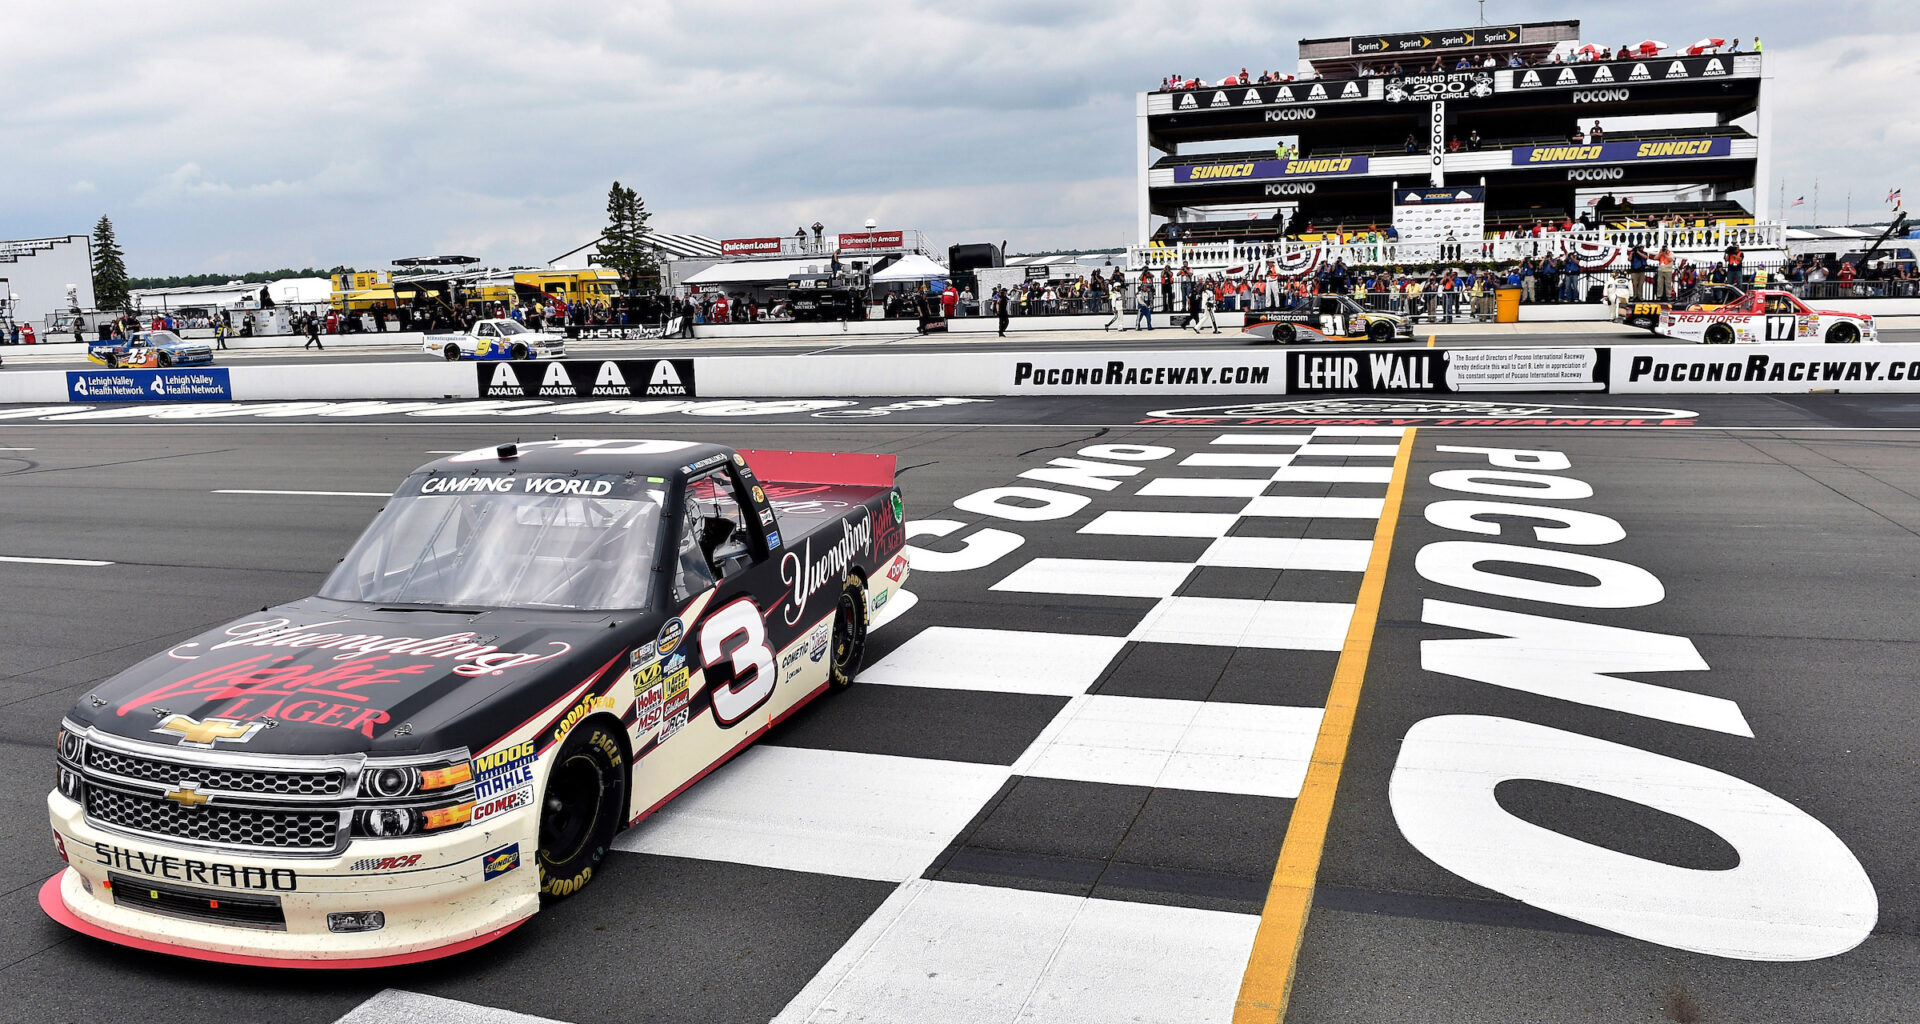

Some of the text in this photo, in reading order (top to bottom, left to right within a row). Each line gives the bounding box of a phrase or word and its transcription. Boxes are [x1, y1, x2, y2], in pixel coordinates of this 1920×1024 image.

[1400, 40, 1421, 49] Sprint
[1442, 36, 1463, 46] Sprint
[1485, 33, 1506, 42] Sprint
[1358, 42, 1379, 52] Sprint
[1405, 72, 1474, 84] RICHARD PETTY
[1414, 82, 1465, 94] 200
[1573, 88, 1630, 103] POCONO
[1408, 93, 1438, 102] VICTORY
[1265, 108, 1316, 122] POCONO
[1433, 103, 1442, 166] POCONO
[1530, 146, 1603, 162] SUNOCO
[1636, 140, 1712, 156] SUNOCO
[1190, 163, 1254, 180] SUNOCO
[1284, 158, 1352, 174] SUNOCO
[1568, 168, 1624, 181] POCONO
[1265, 182, 1316, 196] POCONO
[723, 241, 778, 251] Quicken Loans
[840, 236, 870, 246] Engineered
[1268, 314, 1308, 322] Heater.com
[1320, 314, 1345, 336] 31
[1678, 315, 1752, 324] RED HORSE
[1768, 317, 1794, 340] 17
[475, 339, 492, 356] 9
[128, 348, 148, 364] 23
[1564, 353, 1584, 361] Raceway
[1298, 354, 1434, 389] LEHR WALL
[1551, 362, 1580, 370] appreciation
[88, 376, 134, 386] Lehigh Valley
[165, 375, 213, 385] Lehigh Valley
[89, 386, 144, 395] Health Network
[167, 385, 223, 394] Health Network
[488, 387, 524, 396] AXALTA
[539, 386, 576, 395] AXALTA
[592, 386, 630, 395] AXALTA
[646, 386, 686, 395] AXALTA
[420, 477, 614, 496] CAMPING WORLD
[780, 504, 872, 627] Yuengling
[892, 560, 904, 578] DOW
[168, 618, 572, 677] Yuengling
[699, 597, 776, 724] 3
[117, 654, 438, 716] Light
[638, 688, 662, 712] Holley
[1388, 445, 1879, 962] POCONO
[218, 700, 391, 740] LAGER
[554, 692, 615, 742] GOODYEAR
[638, 706, 662, 732] MSD
[476, 740, 534, 774] MOOG
[589, 731, 622, 768] EAGLE
[481, 755, 534, 780] CHASSIS PARTS
[475, 765, 533, 800] MAHLE
[474, 794, 516, 820] COMP
[504, 798, 525, 811] CAMS
[95, 842, 296, 891] SILVERADO
[376, 854, 422, 870] RCR
[486, 852, 518, 873] SUNOCO
